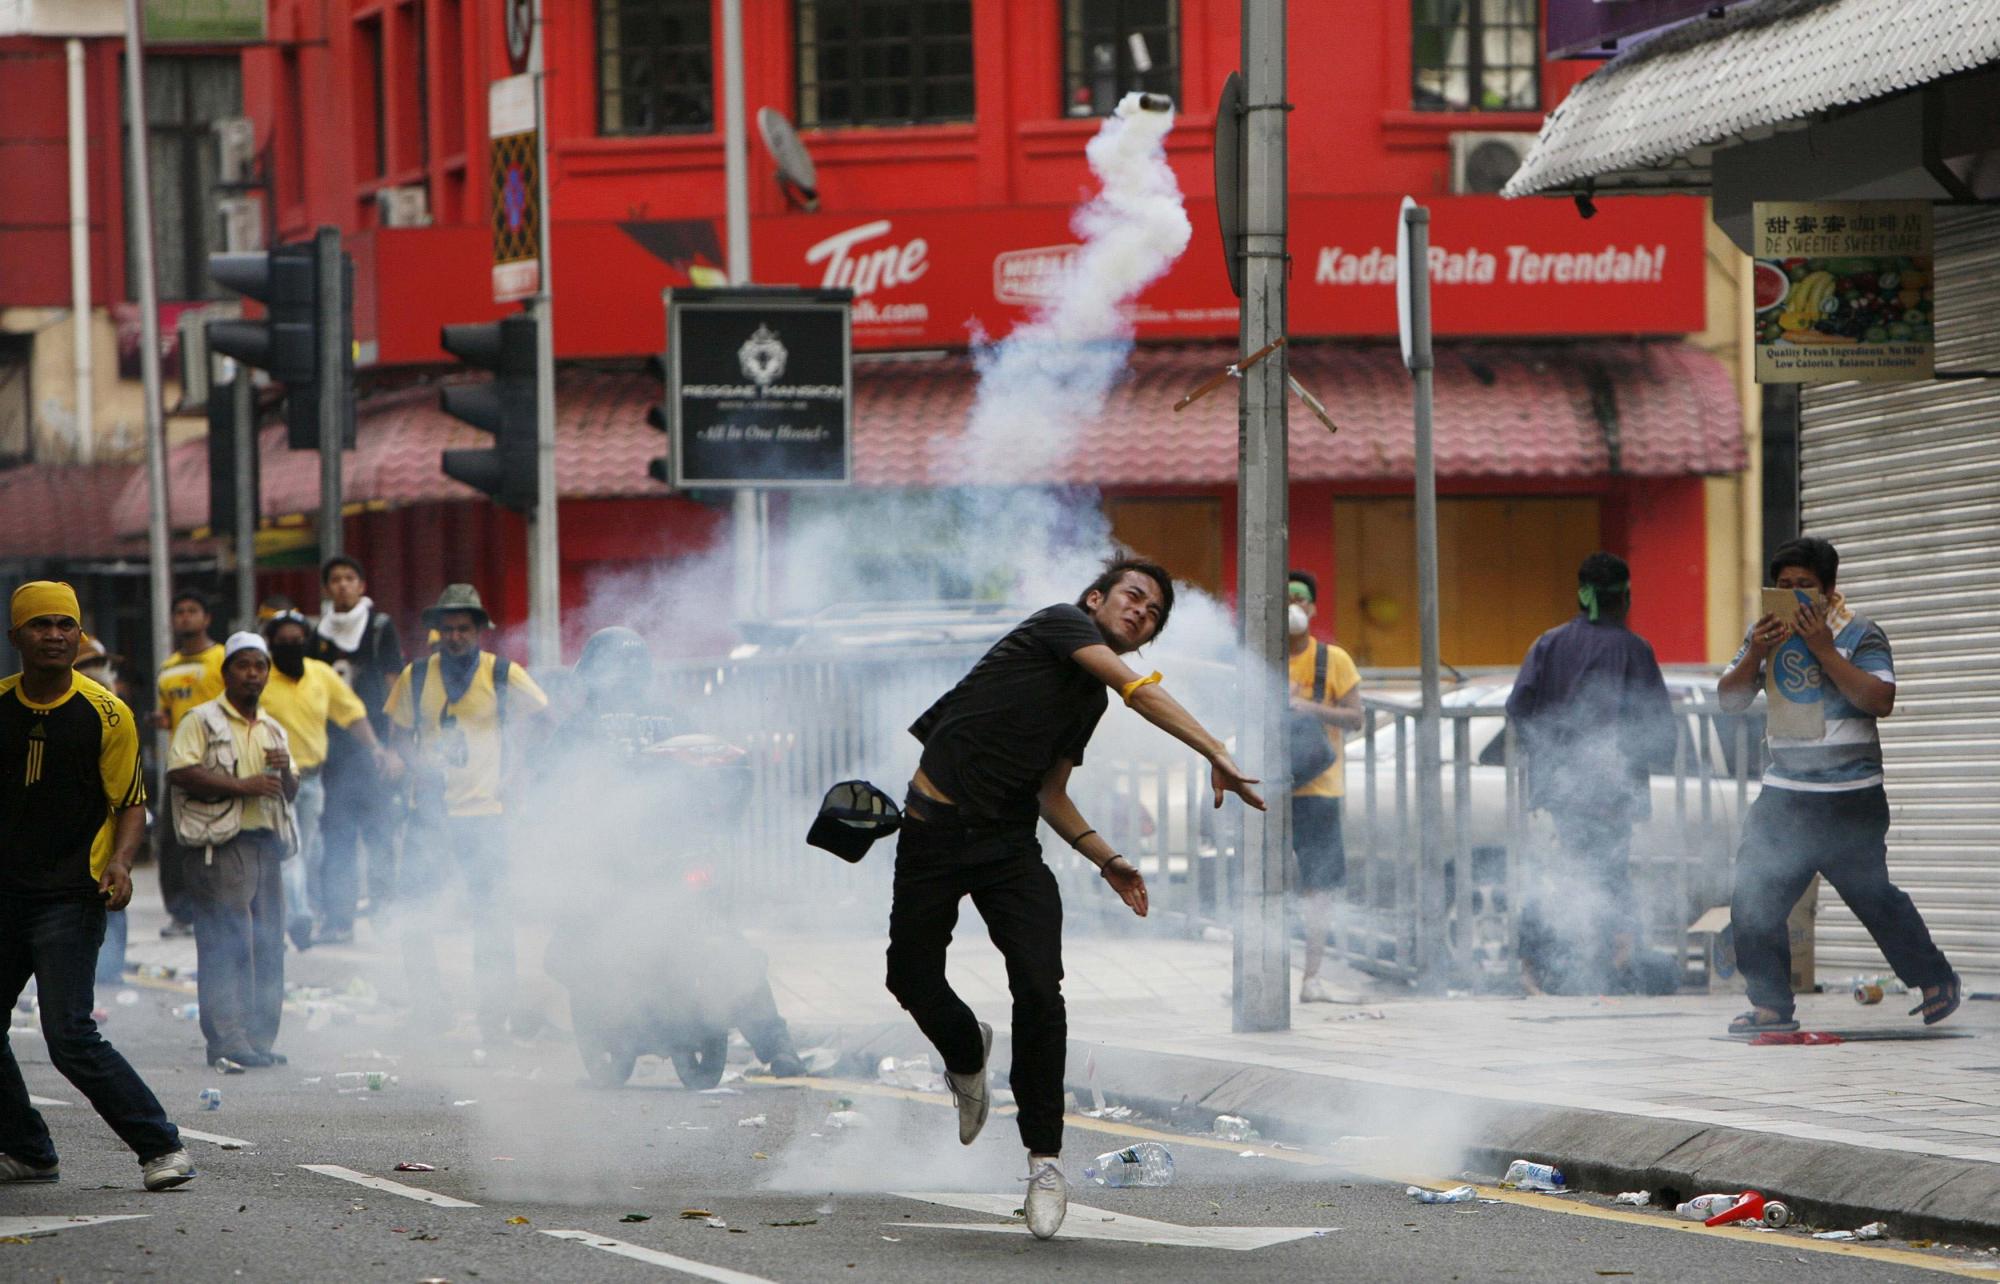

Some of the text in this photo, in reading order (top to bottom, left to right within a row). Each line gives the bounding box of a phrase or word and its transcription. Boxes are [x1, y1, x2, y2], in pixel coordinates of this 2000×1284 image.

[805, 219, 930, 297] Tune
[1315, 245, 1666, 285] Kada Rata Terendah!
